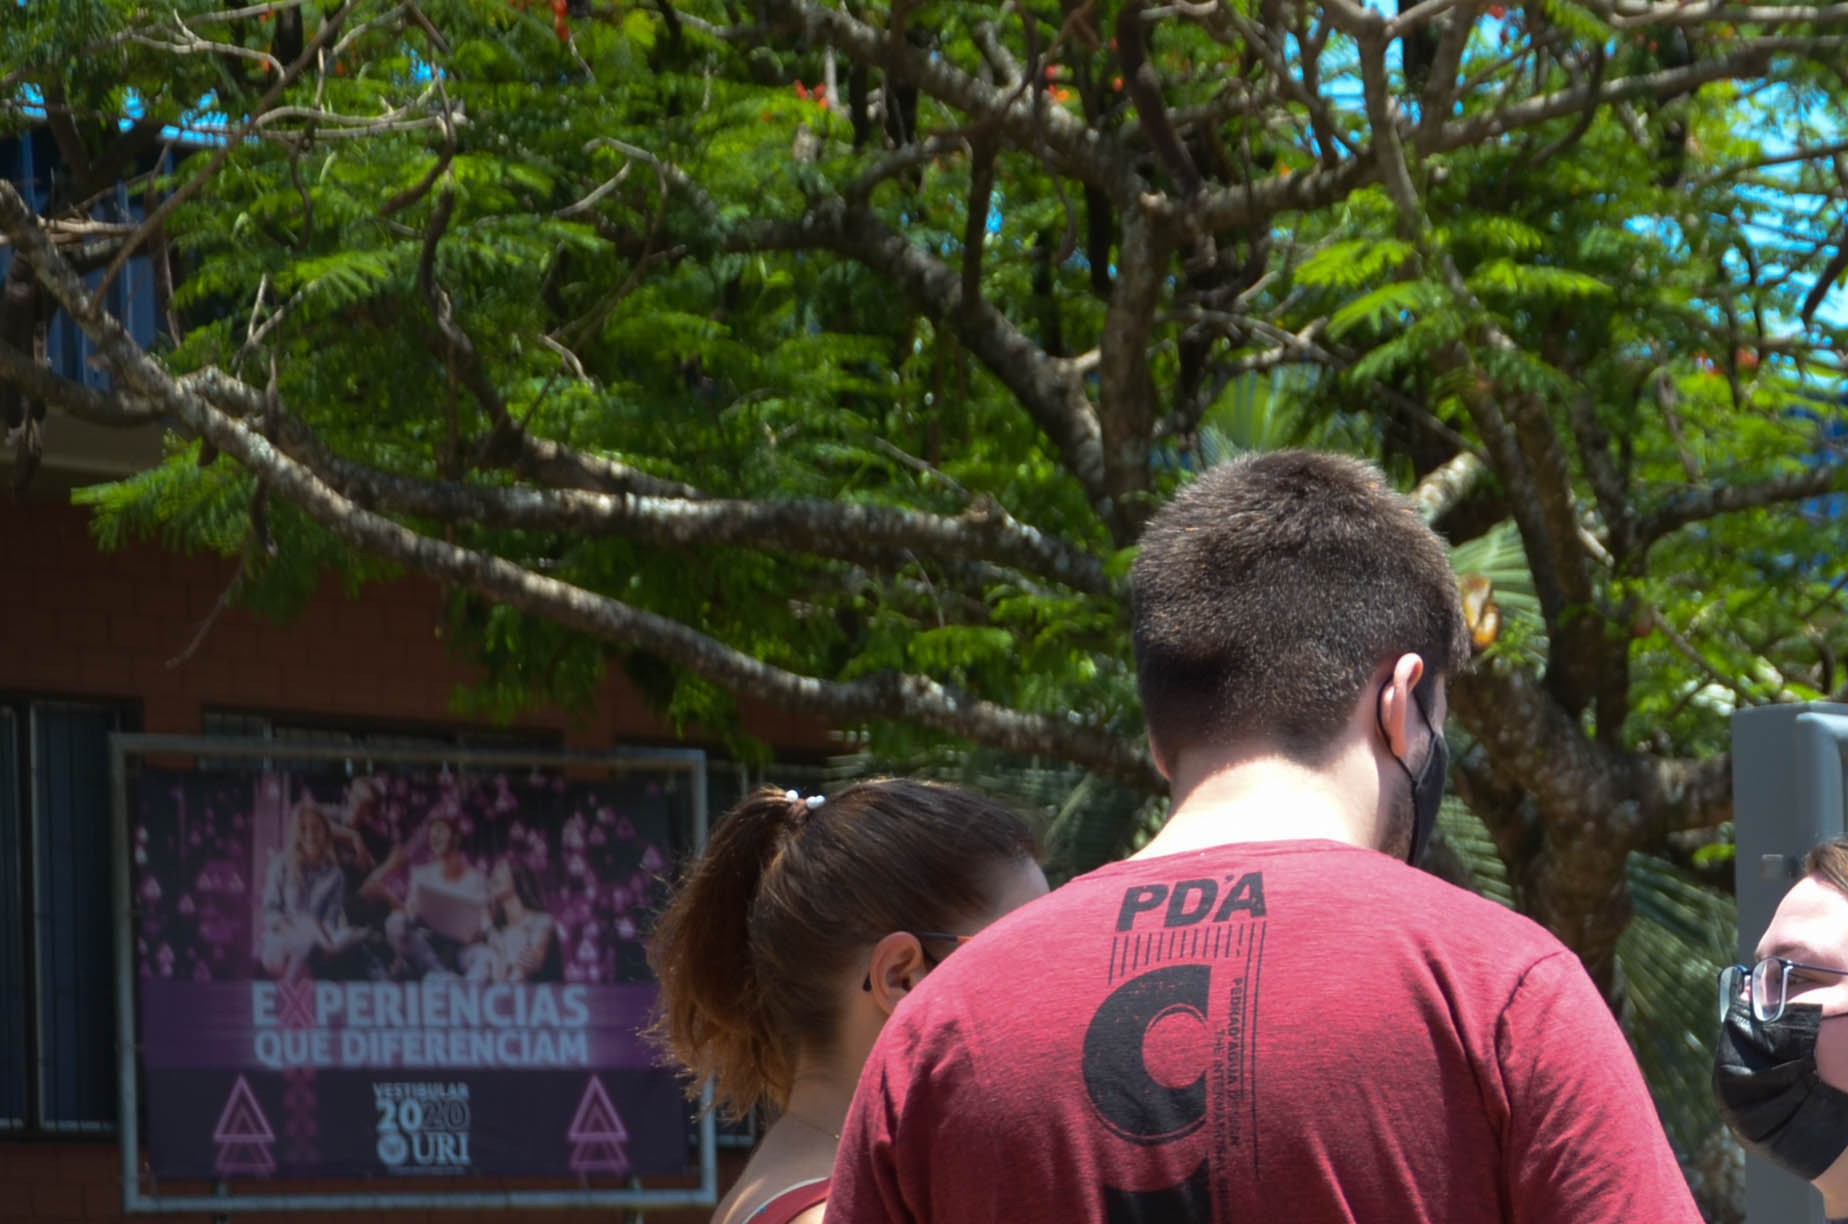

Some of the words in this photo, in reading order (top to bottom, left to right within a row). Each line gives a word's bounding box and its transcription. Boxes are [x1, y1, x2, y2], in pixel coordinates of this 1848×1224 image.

[254, 1029, 332, 1069] QUE
[341, 1029, 589, 1067] DIFERENCIAM
[413, 1132, 472, 1166] URI
